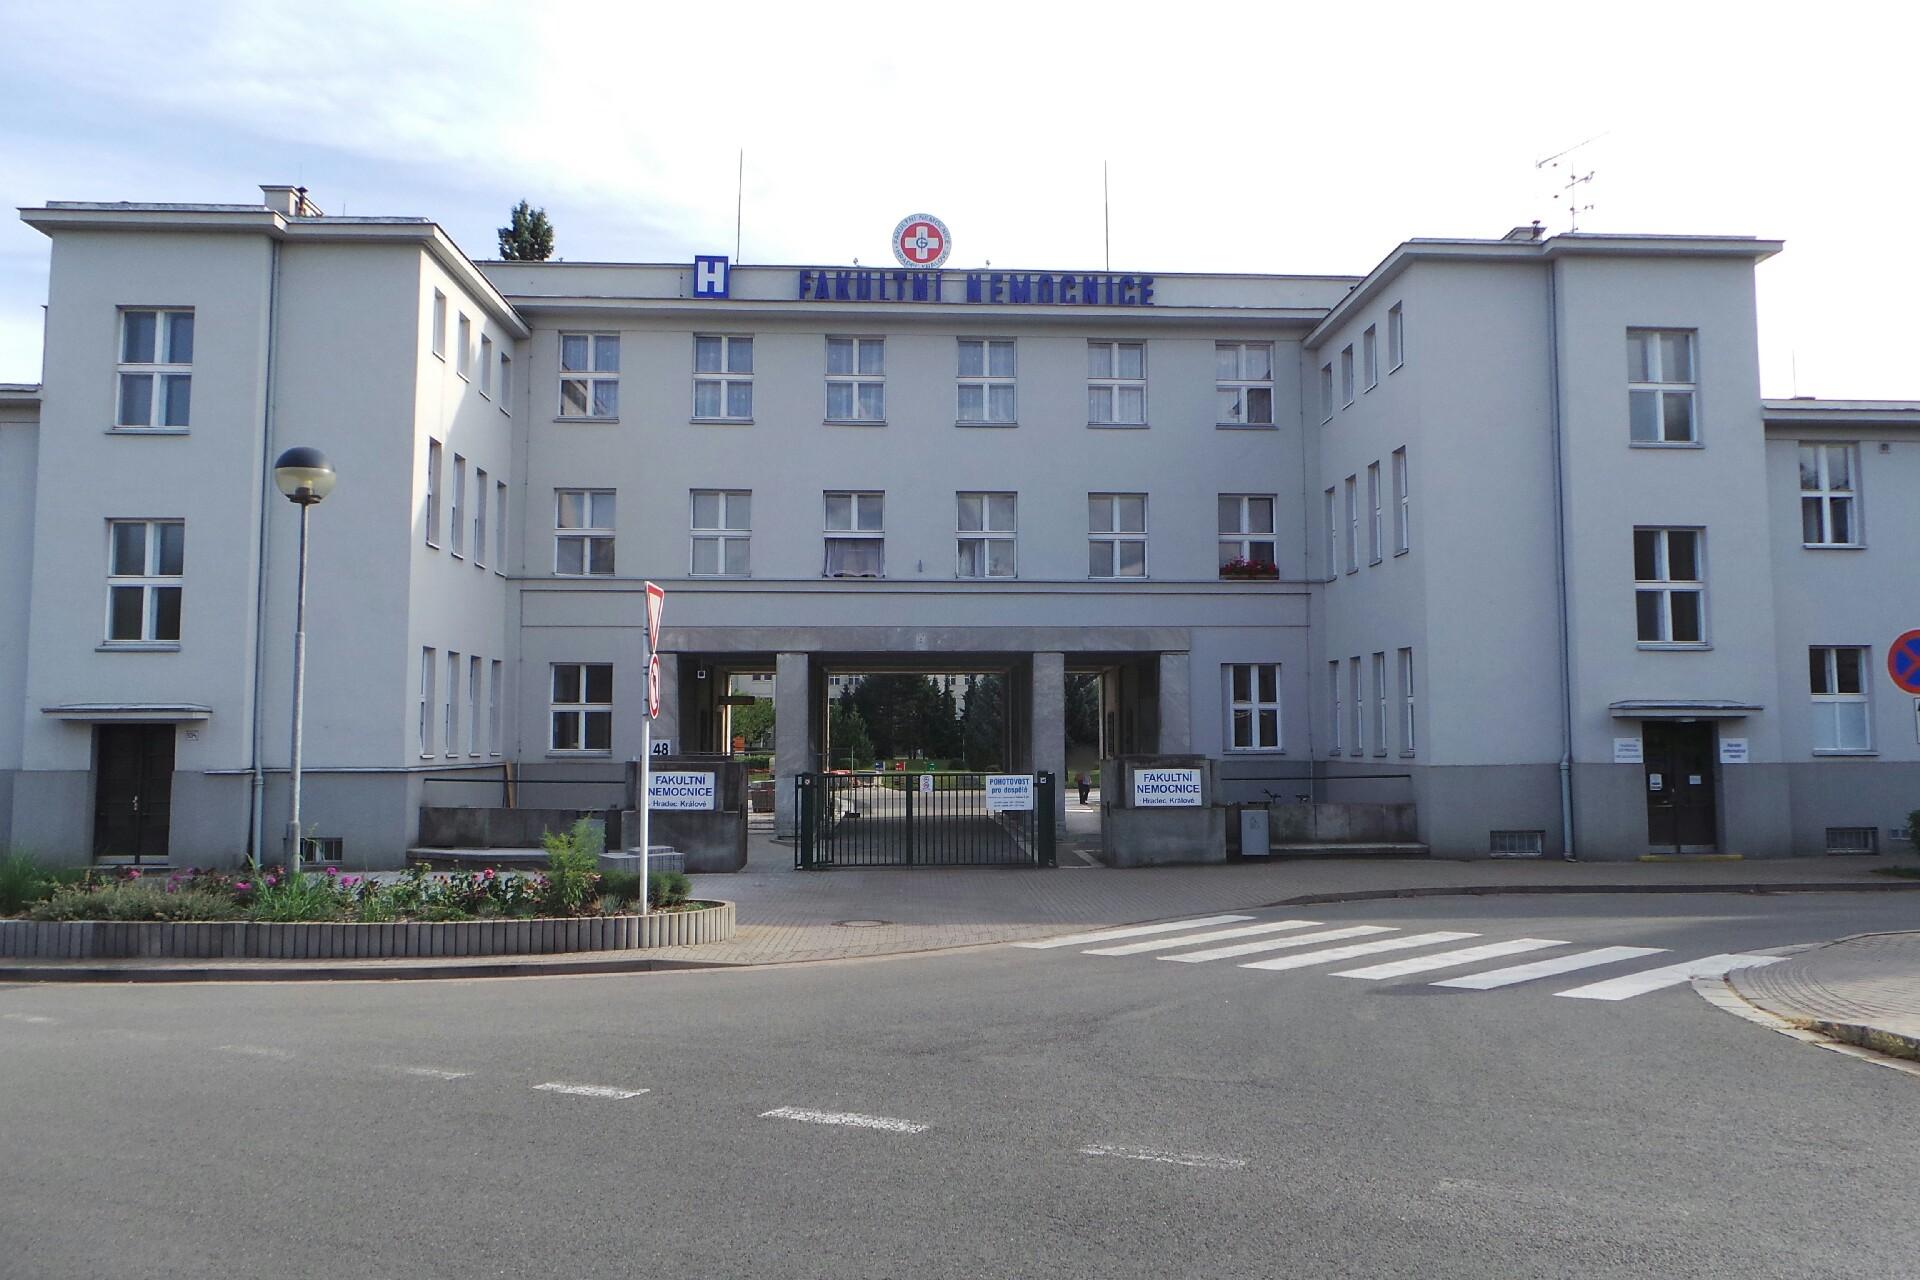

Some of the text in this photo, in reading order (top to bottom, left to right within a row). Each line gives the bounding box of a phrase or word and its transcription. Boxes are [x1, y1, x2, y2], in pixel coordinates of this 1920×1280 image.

[698, 261, 725, 292] H
[966, 272, 1154, 305] NEMOCNICE
[653, 743, 669, 756] 48
[655, 773, 706, 785] FAKULTNÍ
[1143, 771, 1193, 782] FAKULTNÍ
[989, 778, 1030, 786] POHOTOVOST
[648, 787, 713, 797] NEMOCNICE
[991, 787, 1002, 795] pro
[1136, 784, 1200, 794] NEMOCNICE
[680, 800, 707, 808] Králové
